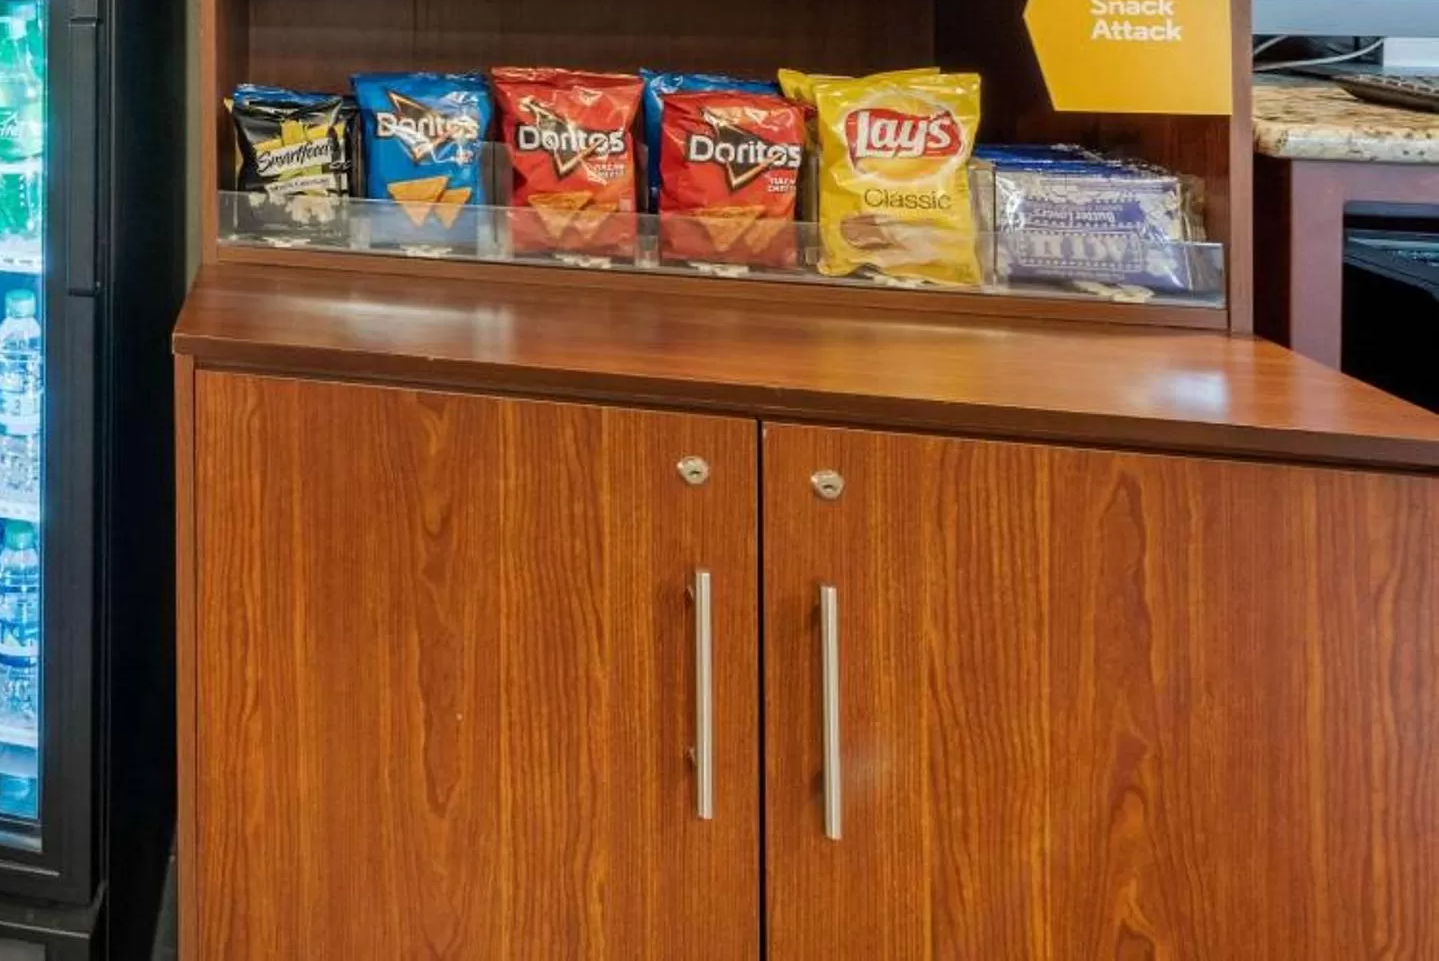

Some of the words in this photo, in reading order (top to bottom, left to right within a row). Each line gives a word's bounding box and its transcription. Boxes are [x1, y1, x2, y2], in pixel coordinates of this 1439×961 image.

[1091, 18, 1183, 41] Attack
[518, 124, 625, 153] Doritos
[855, 109, 954, 158] Lay's
[689, 134, 802, 168] Doritos
[864, 188, 953, 211] Classic
